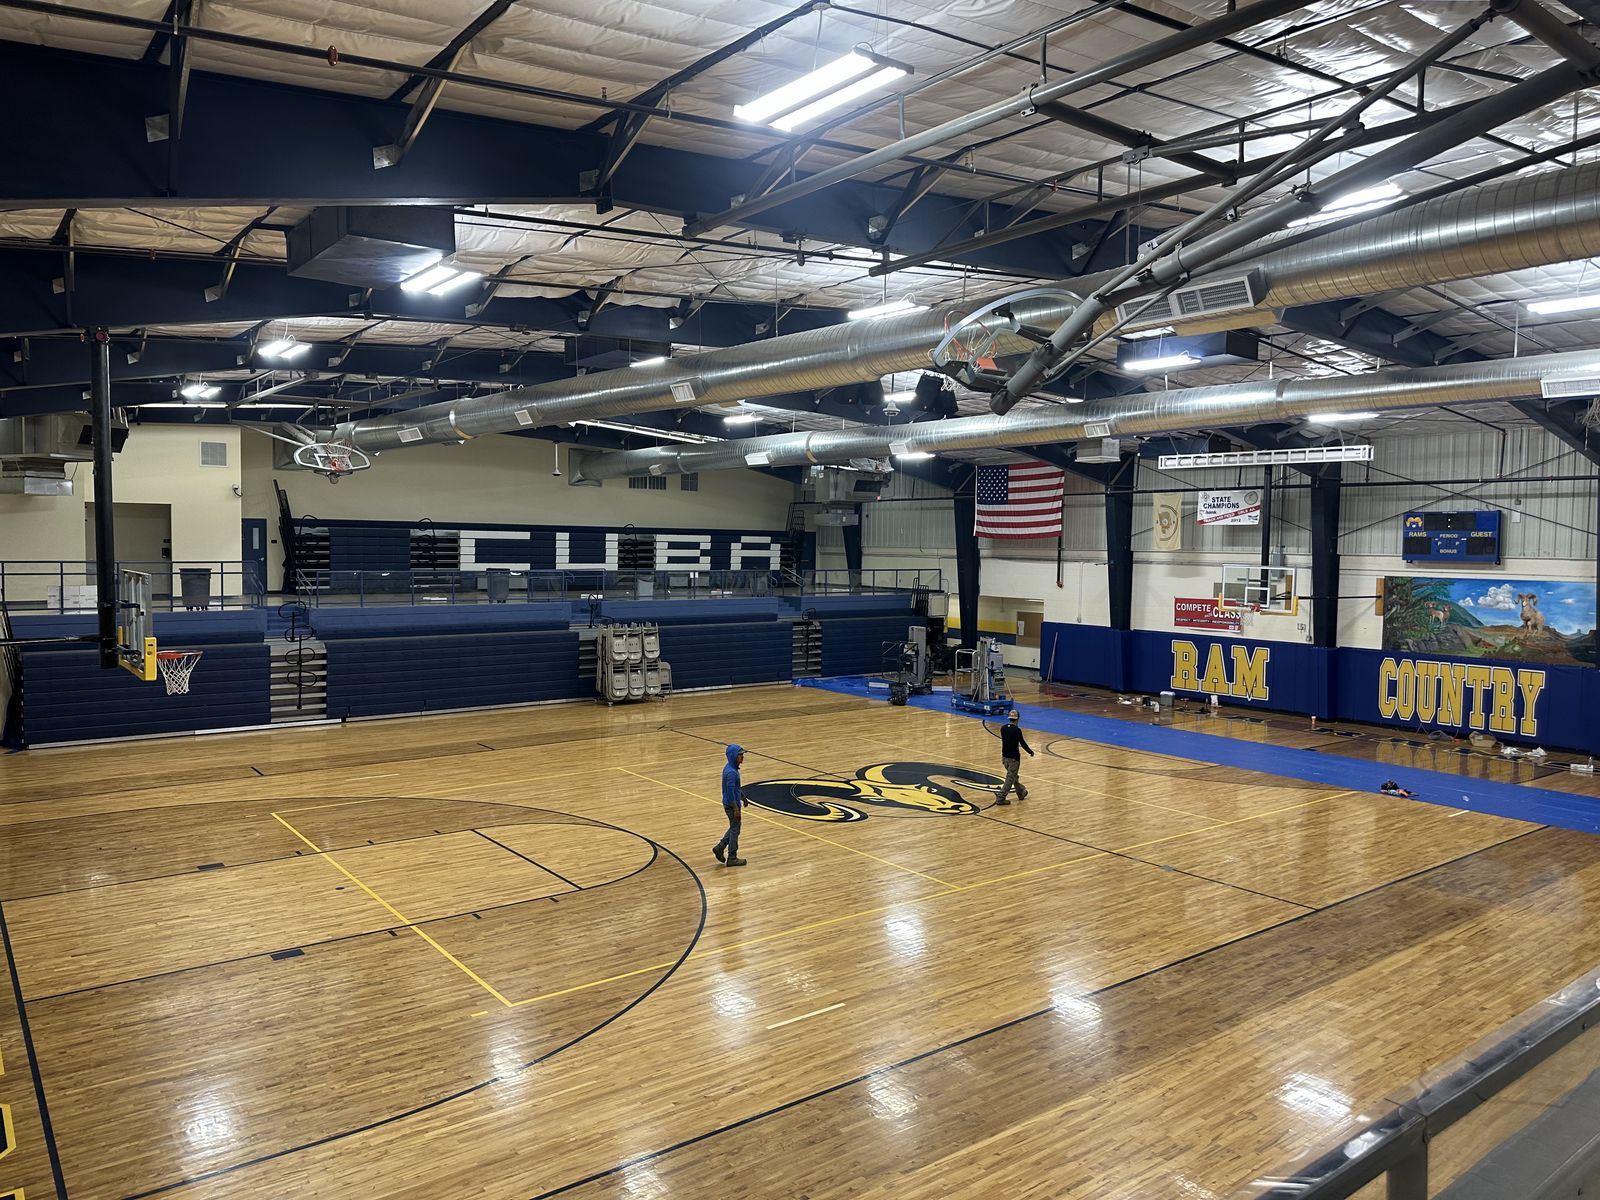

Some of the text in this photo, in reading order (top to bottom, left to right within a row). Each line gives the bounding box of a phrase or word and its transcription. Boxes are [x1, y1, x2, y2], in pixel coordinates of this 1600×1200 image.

[460, 530, 781, 571] CUBA
[1175, 603, 1212, 613] COMPETE
[1171, 640, 1546, 737] RAM COUNTRY
